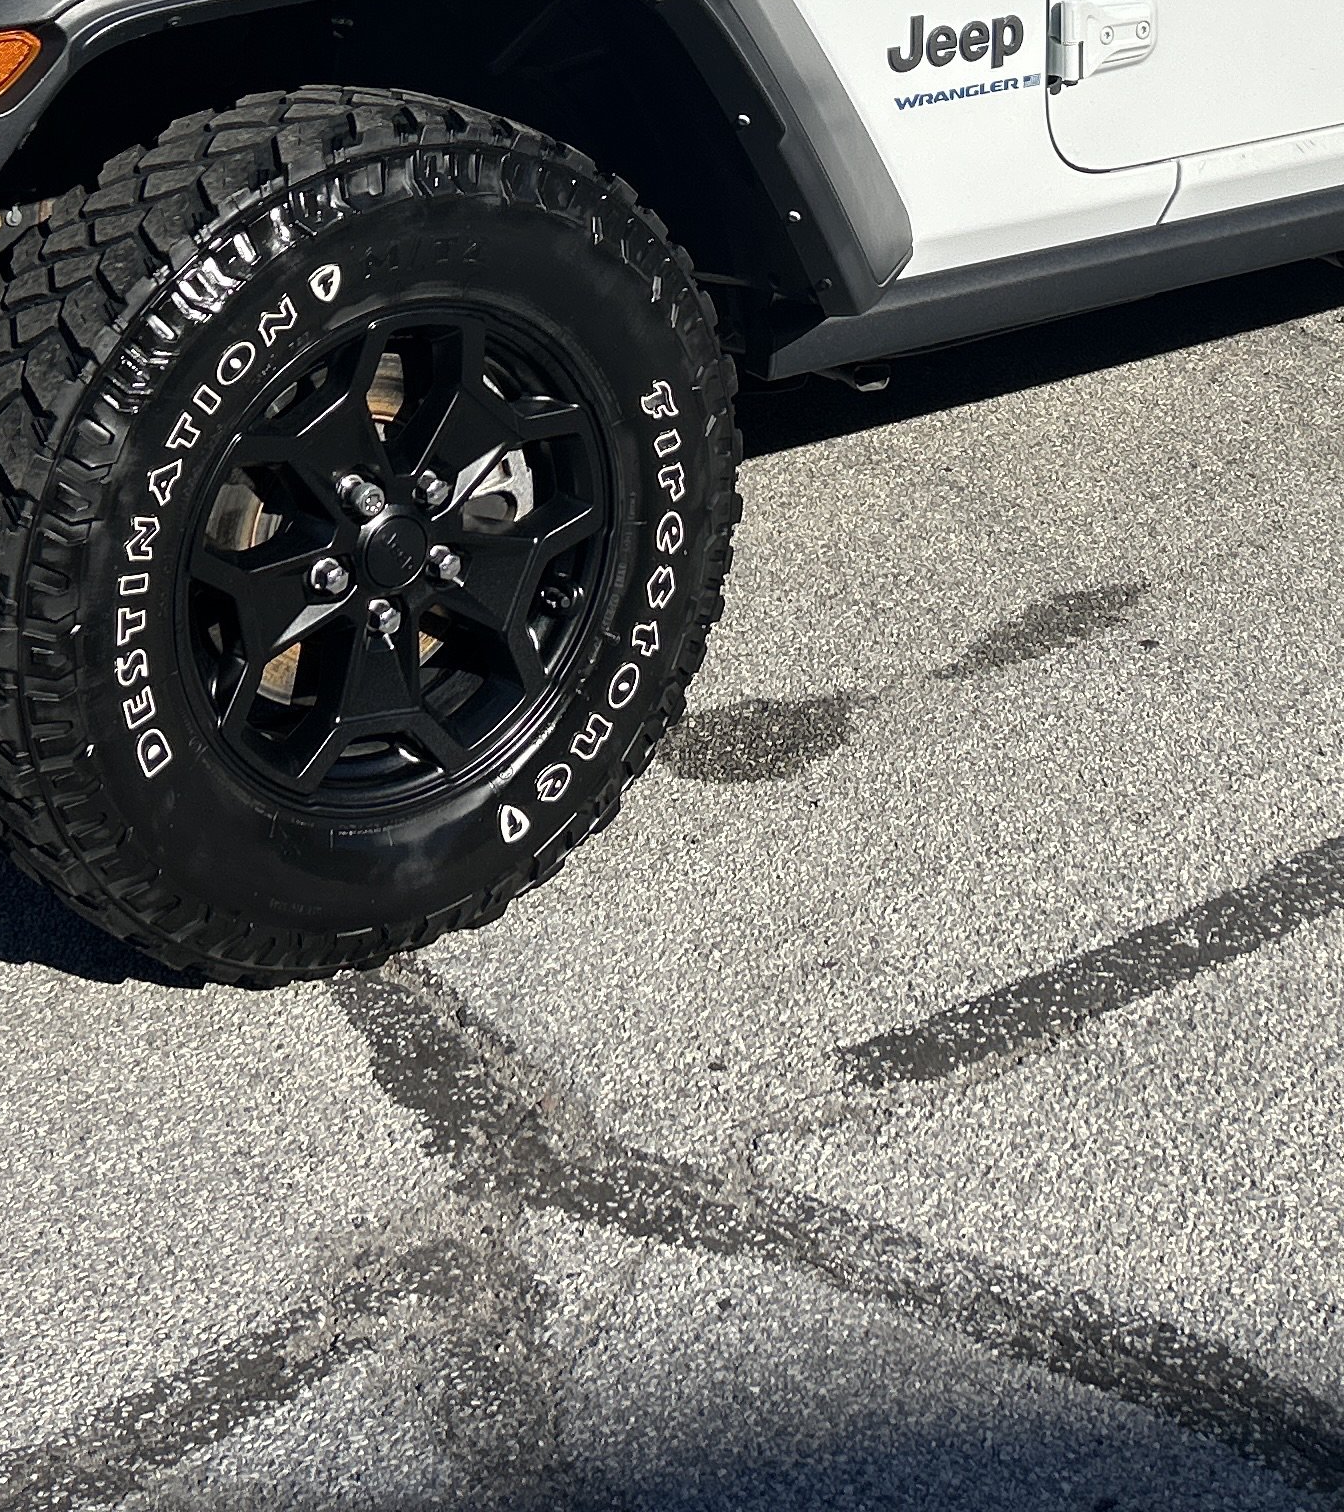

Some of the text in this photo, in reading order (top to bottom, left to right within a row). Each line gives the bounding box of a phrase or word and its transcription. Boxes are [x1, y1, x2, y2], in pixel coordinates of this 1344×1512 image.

[887, 14, 1025, 73] Jeep
[894, 77, 1019, 111] WRANGLER
[115, 295, 298, 777] DESTINATION
